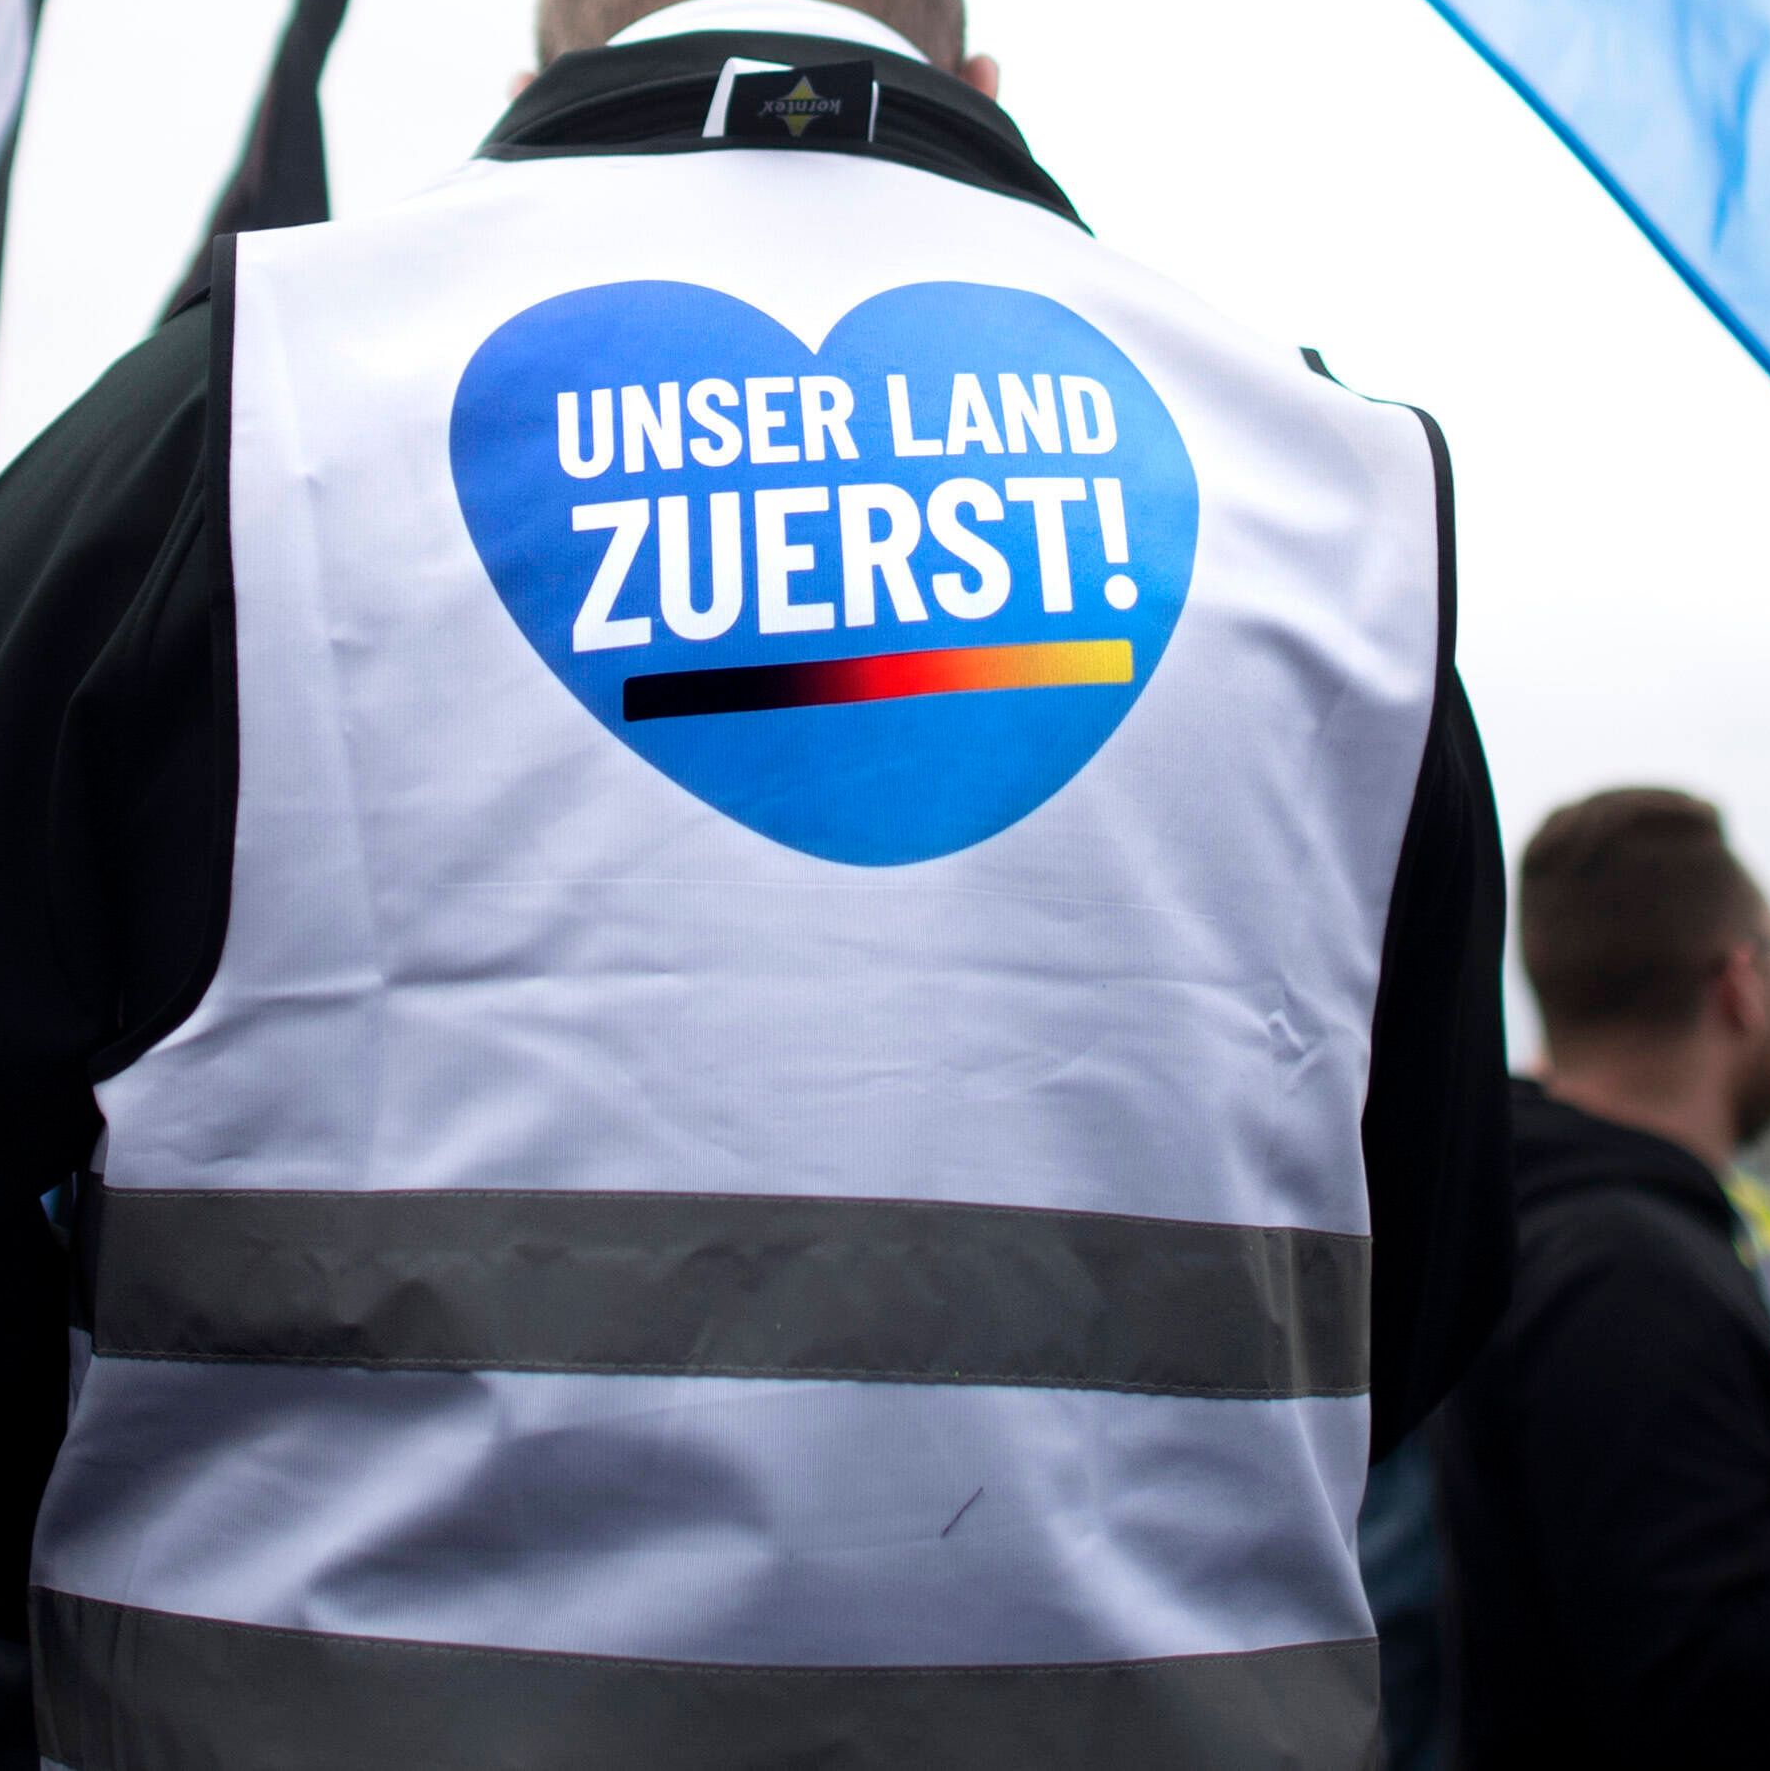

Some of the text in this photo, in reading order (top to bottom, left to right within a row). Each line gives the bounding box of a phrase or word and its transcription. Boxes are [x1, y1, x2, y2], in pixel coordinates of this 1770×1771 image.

[760, 98, 842, 116] korntex
[556, 372, 1119, 479] UNSER LAND
[570, 476, 1139, 654] ZUERST!
